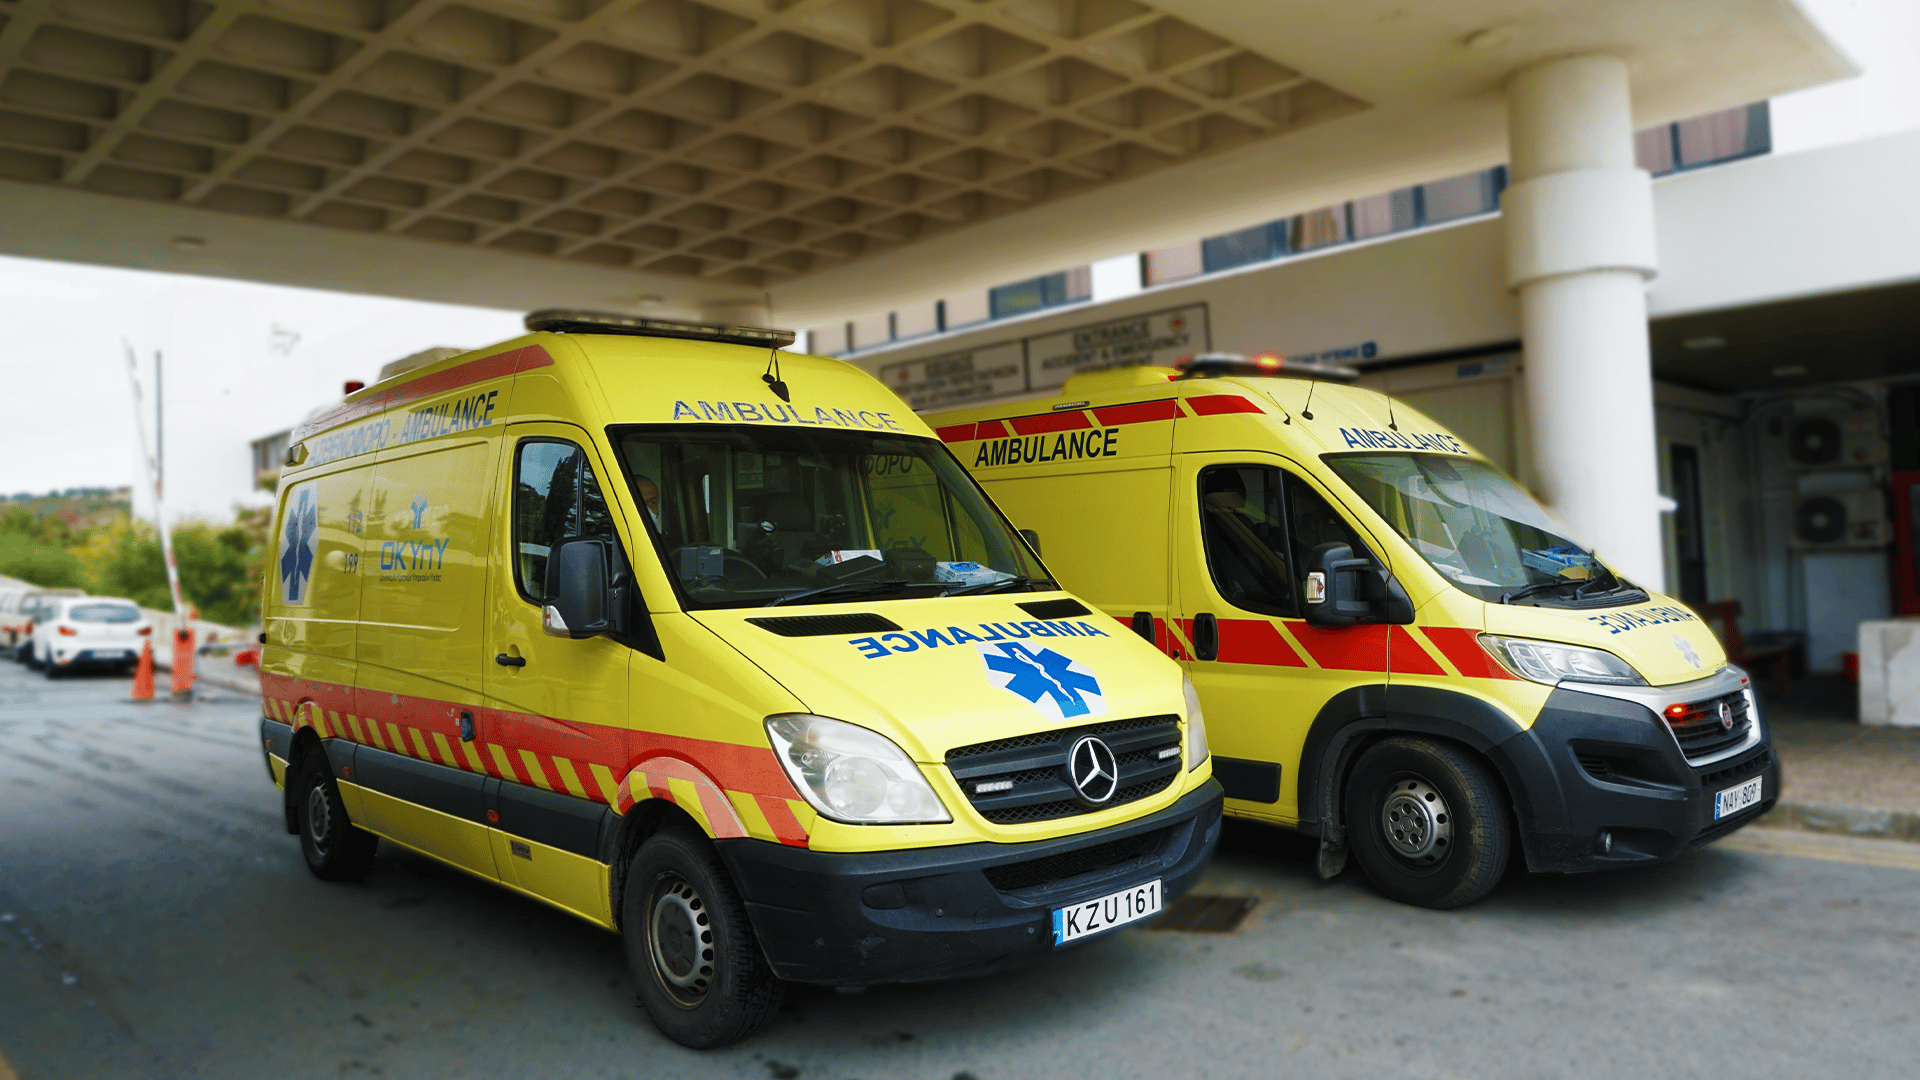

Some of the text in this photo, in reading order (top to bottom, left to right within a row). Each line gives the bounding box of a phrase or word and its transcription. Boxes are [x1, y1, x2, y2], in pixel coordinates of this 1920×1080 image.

[399, 390, 499, 444] AMBULANCE
[673, 400, 904, 431] AMBULANCE
[975, 428, 1119, 467] AMBULANCE
[1339, 427, 1468, 455] AMBULANCE
[347, 512, 363, 534] 112
[344, 553, 358, 574] 199
[1722, 790, 1739, 813] NAY
[1742, 783, 1757, 804] 809
[1067, 885, 1155, 936] KZU 161
